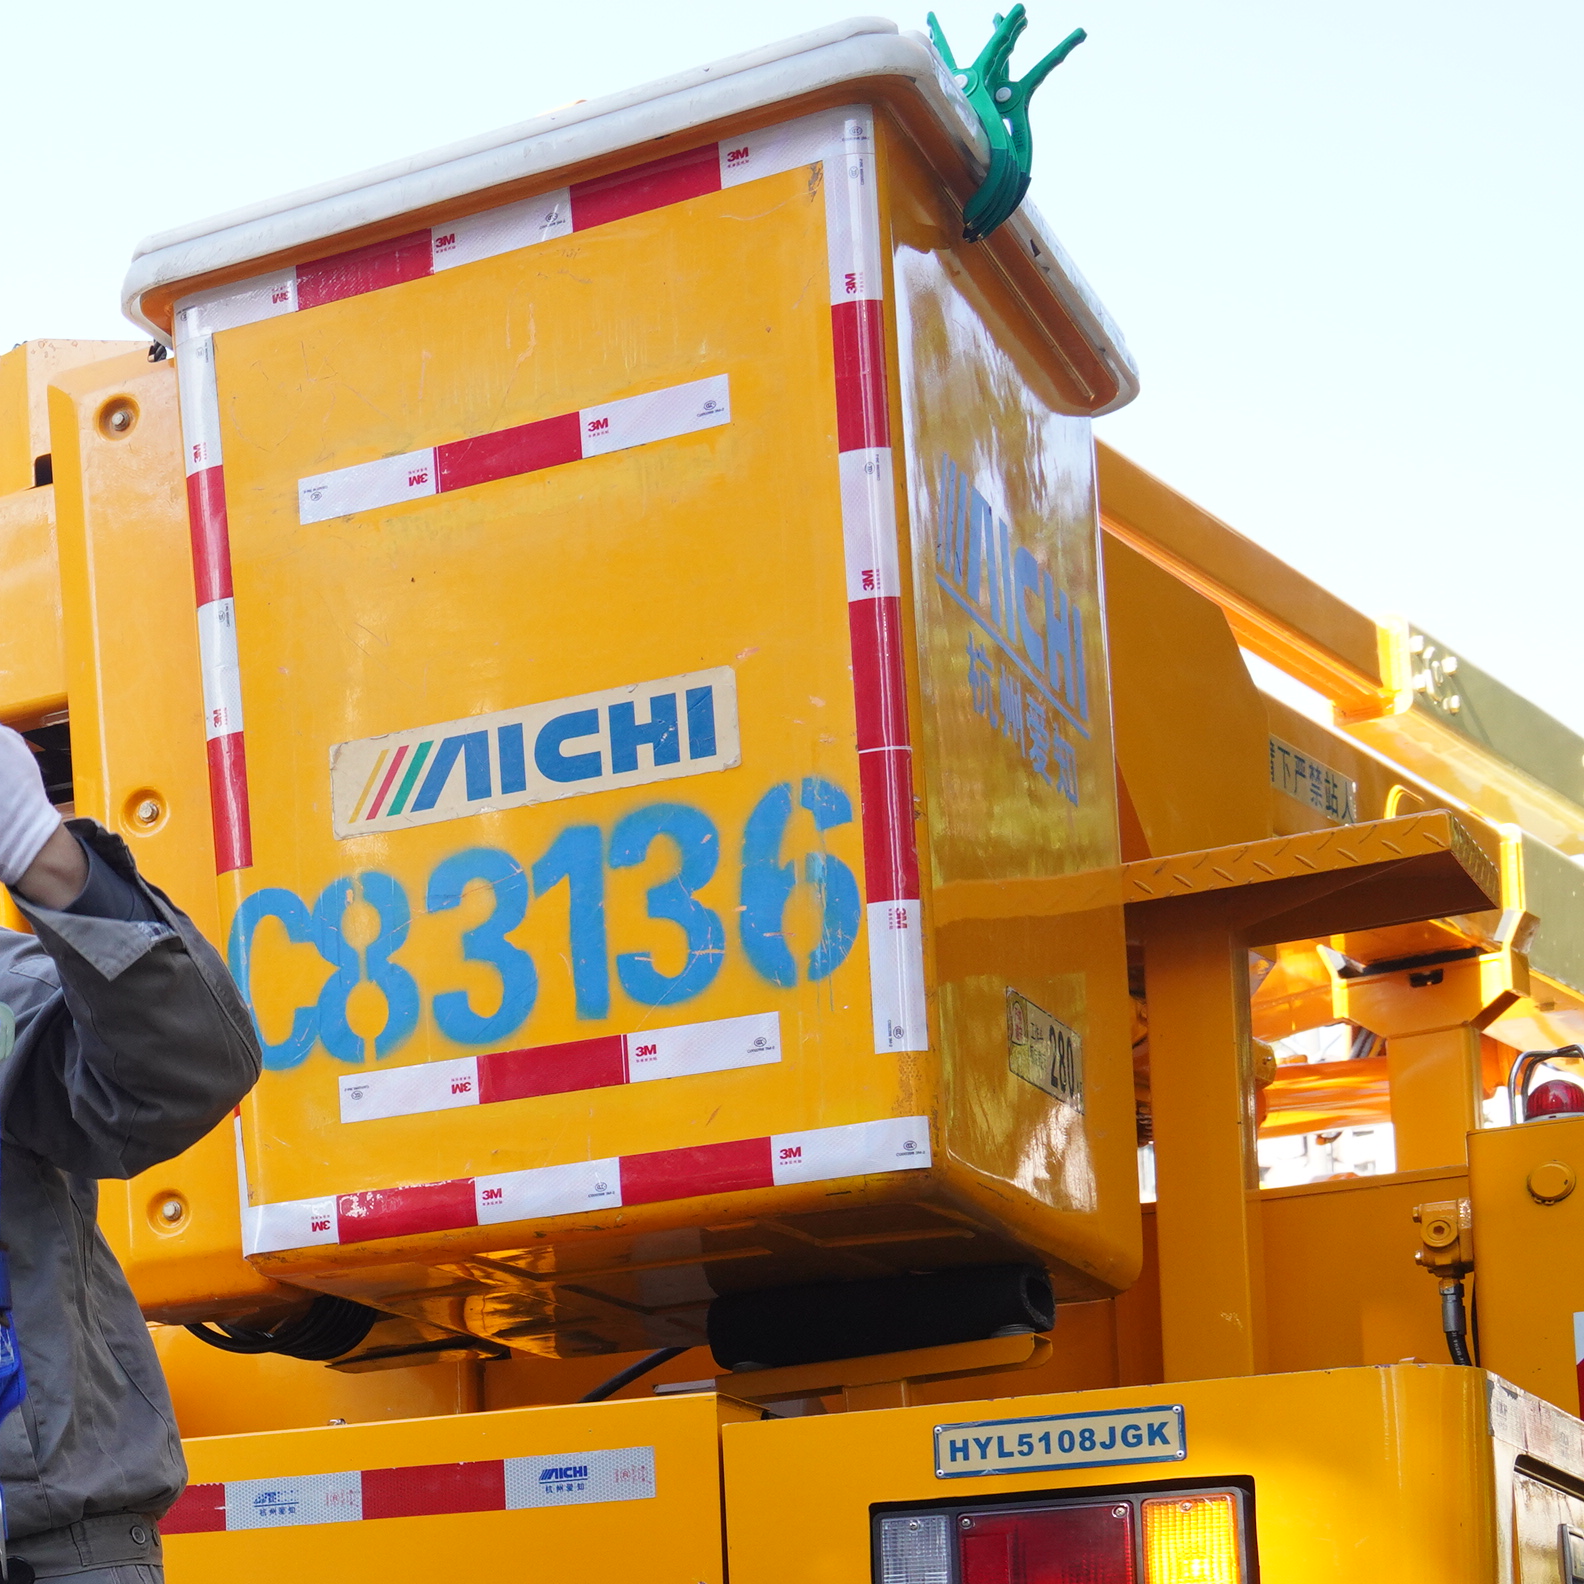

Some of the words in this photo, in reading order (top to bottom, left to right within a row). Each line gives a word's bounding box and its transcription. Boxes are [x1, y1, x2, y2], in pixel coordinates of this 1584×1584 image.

[727, 146, 749, 163] 3M
[435, 233, 456, 248] 3M
[844, 271, 859, 295] 3M
[588, 417, 609, 432] 3M
[408, 472, 428, 487] 3M
[862, 569, 875, 592] 3M
[965, 484, 1089, 722] AICHI
[213, 708, 223, 728] 3M
[965, 631, 1079, 809] 杭州爱知
[408, 684, 718, 814] AICHI
[228, 776, 863, 1071] C83136
[635, 1043, 657, 1058] 3M
[1049, 1024, 1075, 1099] 280
[451, 1081, 472, 1095] 3M
[780, 1146, 802, 1160] 3M
[482, 1188, 503, 1201] 3M
[311, 1220, 331, 1232] 3M
[949, 1421, 1171, 1463] HYL5108JGK
[546, 1465, 588, 1480] AICHI
